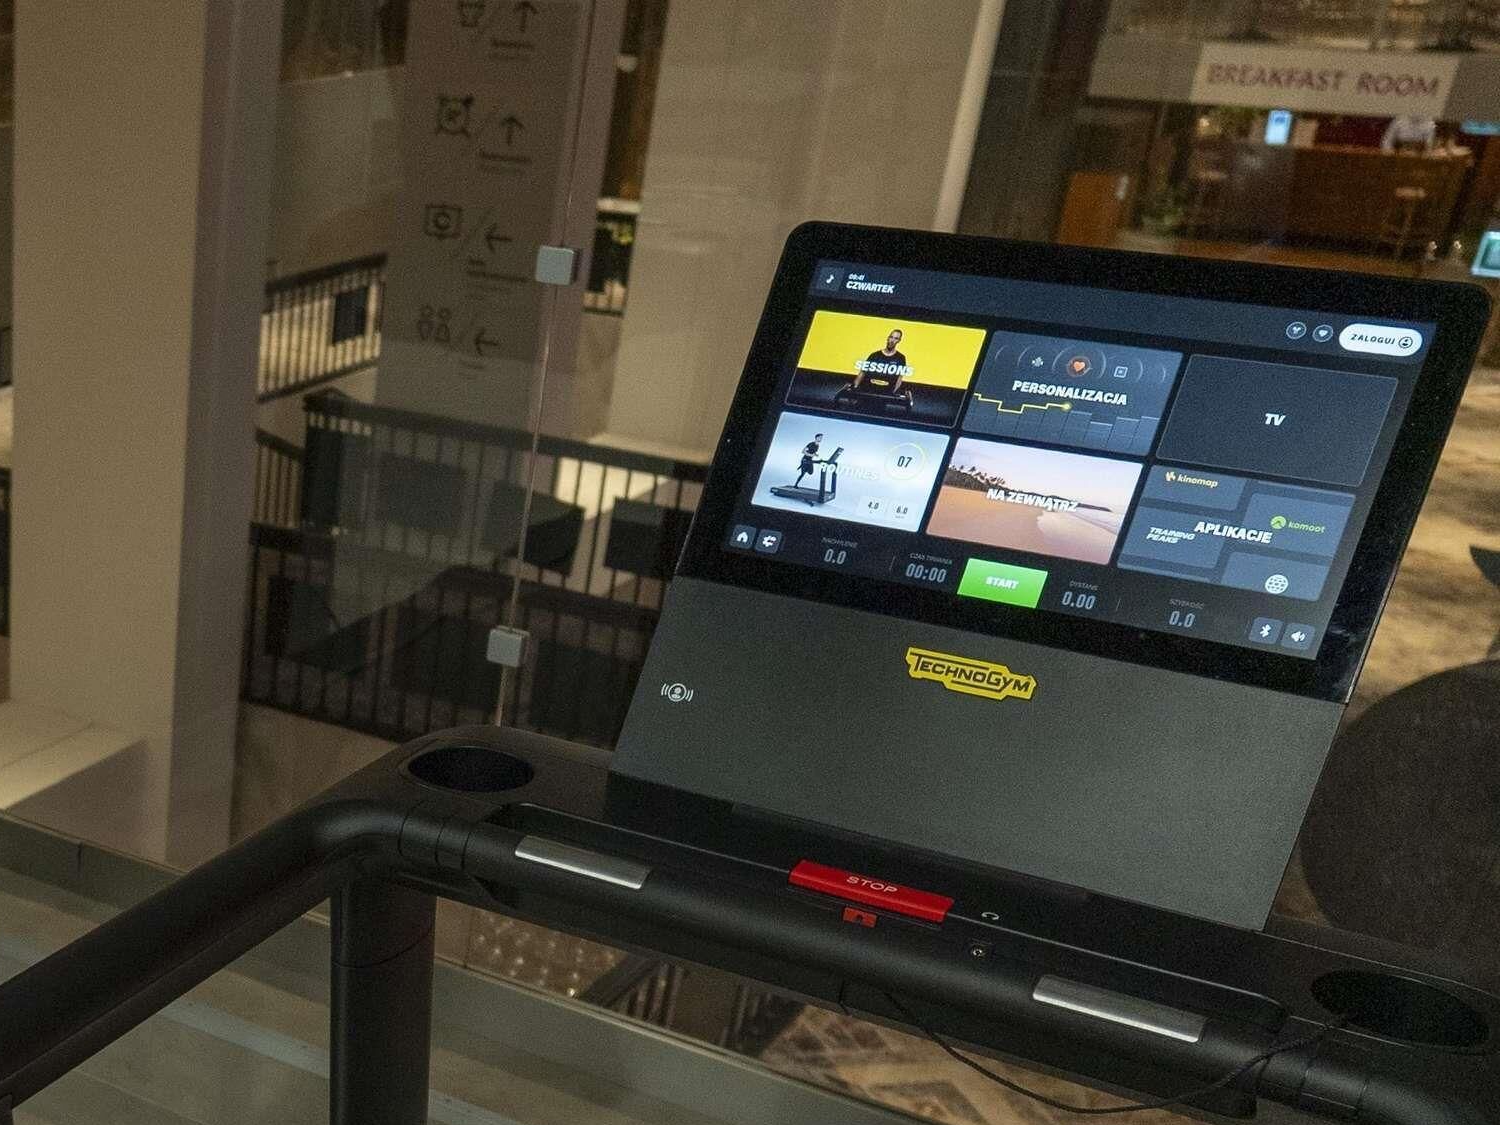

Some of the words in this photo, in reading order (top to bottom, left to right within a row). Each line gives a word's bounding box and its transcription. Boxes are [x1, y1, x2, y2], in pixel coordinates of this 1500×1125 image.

[1205, 63, 1346, 92] BREAKFAST
[1355, 72, 1440, 98] ROOM
[846, 281, 895, 294] CZWARTEK
[1350, 333, 1396, 345] ZALOGUJ
[854, 360, 915, 377] SESSIONS
[1012, 380, 1127, 406] PERSONALIZACJA
[1264, 413, 1286, 426] TV
[897, 455, 912, 468] 07
[1177, 473, 1218, 489] kinomap
[986, 488, 1005, 501] NA
[1006, 490, 1079, 513] ZEWNĄTRZ
[1149, 526, 1195, 541] TRAINING
[1194, 521, 1273, 545] APLIKACJE
[1287, 520, 1326, 534] komoot
[1146, 533, 1179, 544] PEAKS
[824, 549, 846, 565] 0.0
[905, 563, 947, 583] 00:00
[985, 575, 1019, 590] START
[1061, 591, 1096, 610] 0.00
[1168, 610, 1196, 628] 0.0
[846, 875, 899, 893] STOP
